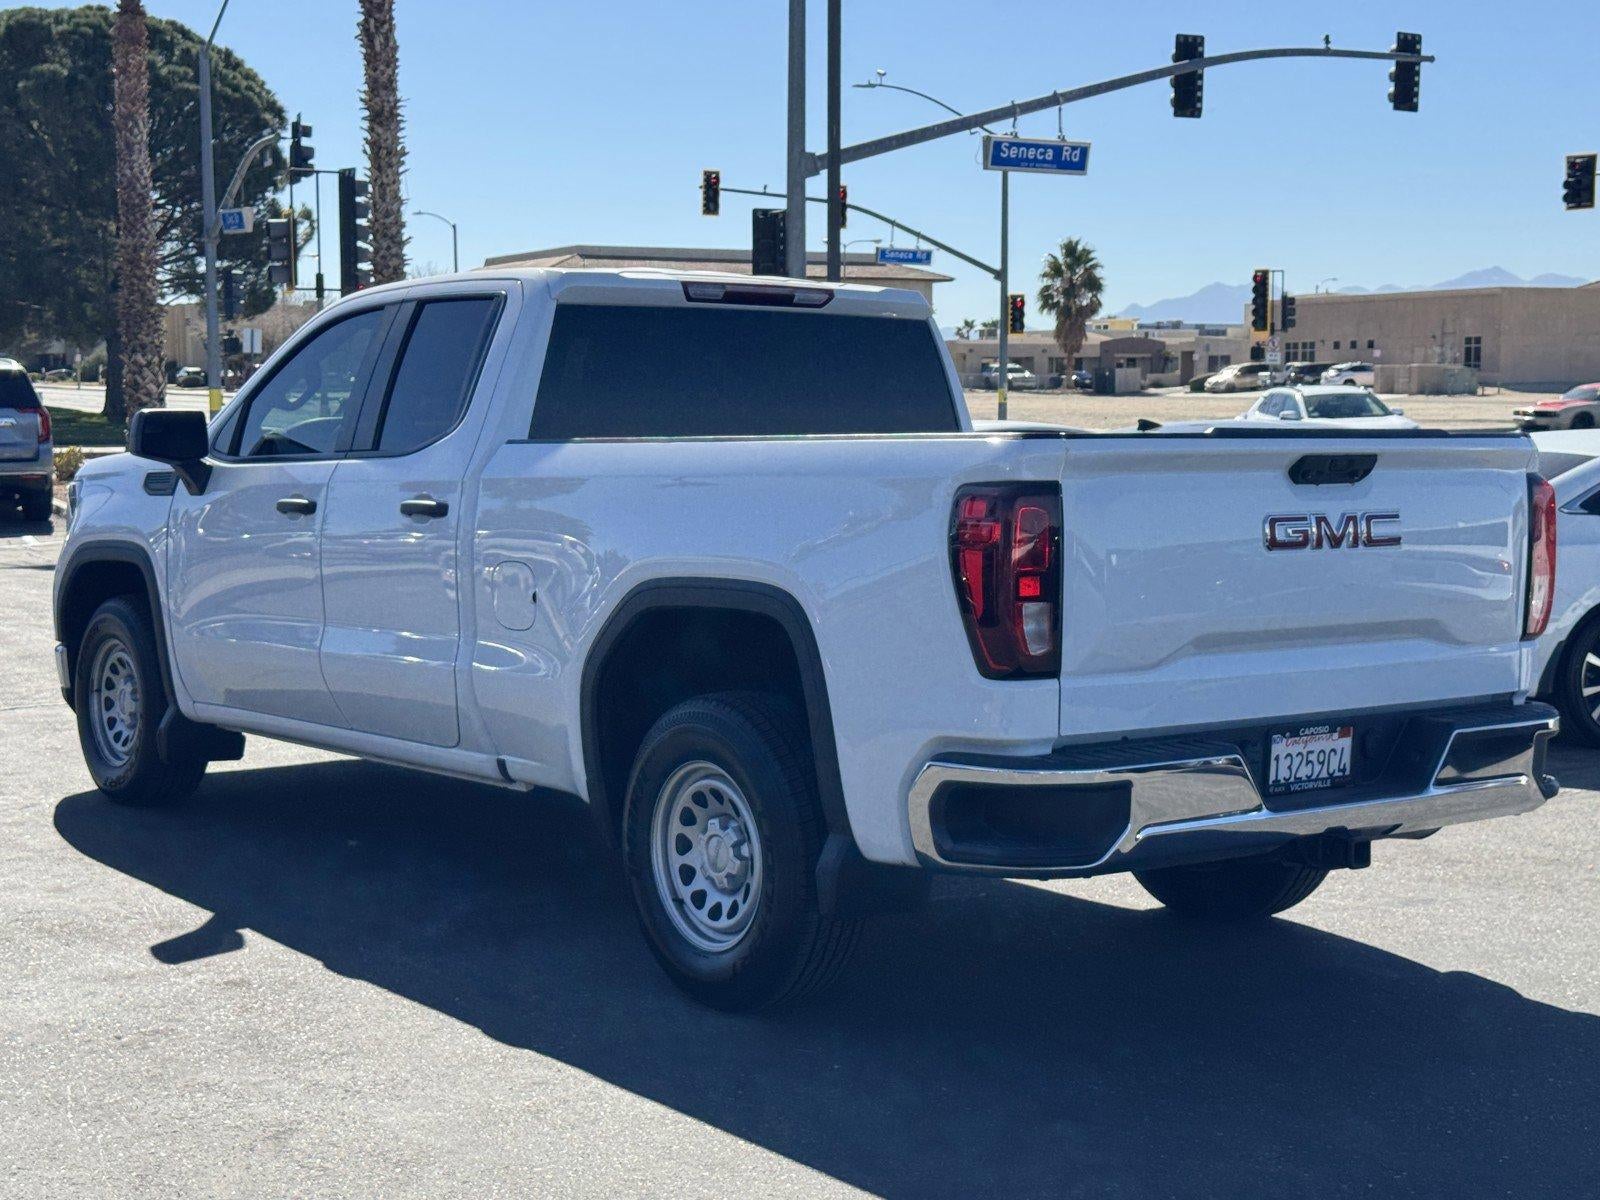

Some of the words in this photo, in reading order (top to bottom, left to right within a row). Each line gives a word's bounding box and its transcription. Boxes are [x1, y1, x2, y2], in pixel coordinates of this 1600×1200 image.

[999, 142, 1054, 160] Seneca
[1061, 146, 1081, 162] Rd
[1263, 511, 1402, 551] GMC
[1299, 725, 1330, 736] CAPOSIO
[1271, 746, 1348, 784] 13259C4
[1290, 778, 1332, 792] VICTORVILLE
